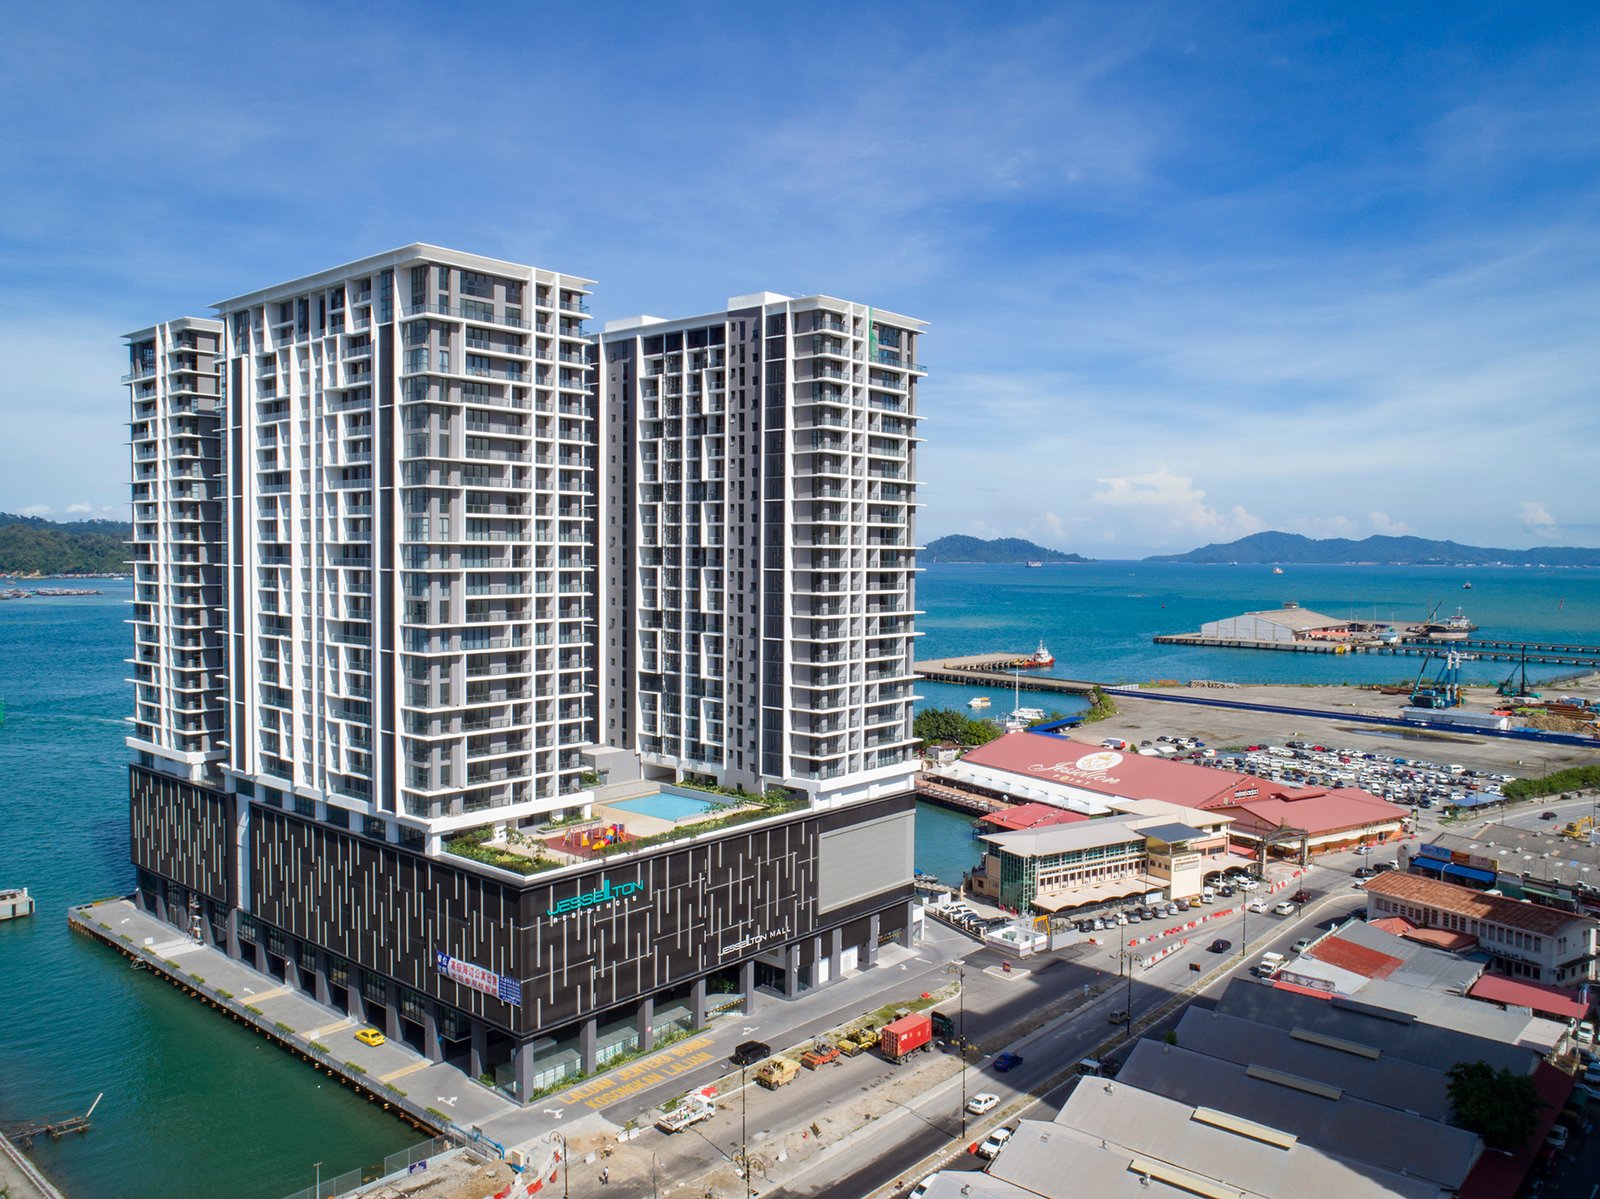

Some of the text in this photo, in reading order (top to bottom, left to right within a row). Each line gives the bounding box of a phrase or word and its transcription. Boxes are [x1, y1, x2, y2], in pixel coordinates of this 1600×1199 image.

[1052, 774, 1091, 785] POINT
[546, 879, 644, 916] JESSELTON
[553, 895, 637, 923] RESIDENCES
[717, 926, 791, 956] JESSELTON MALL
[560, 1037, 715, 1105] LALUAN JENTERA BOMBA
[584, 1051, 714, 1110] KOSONGKAN LALUAN
